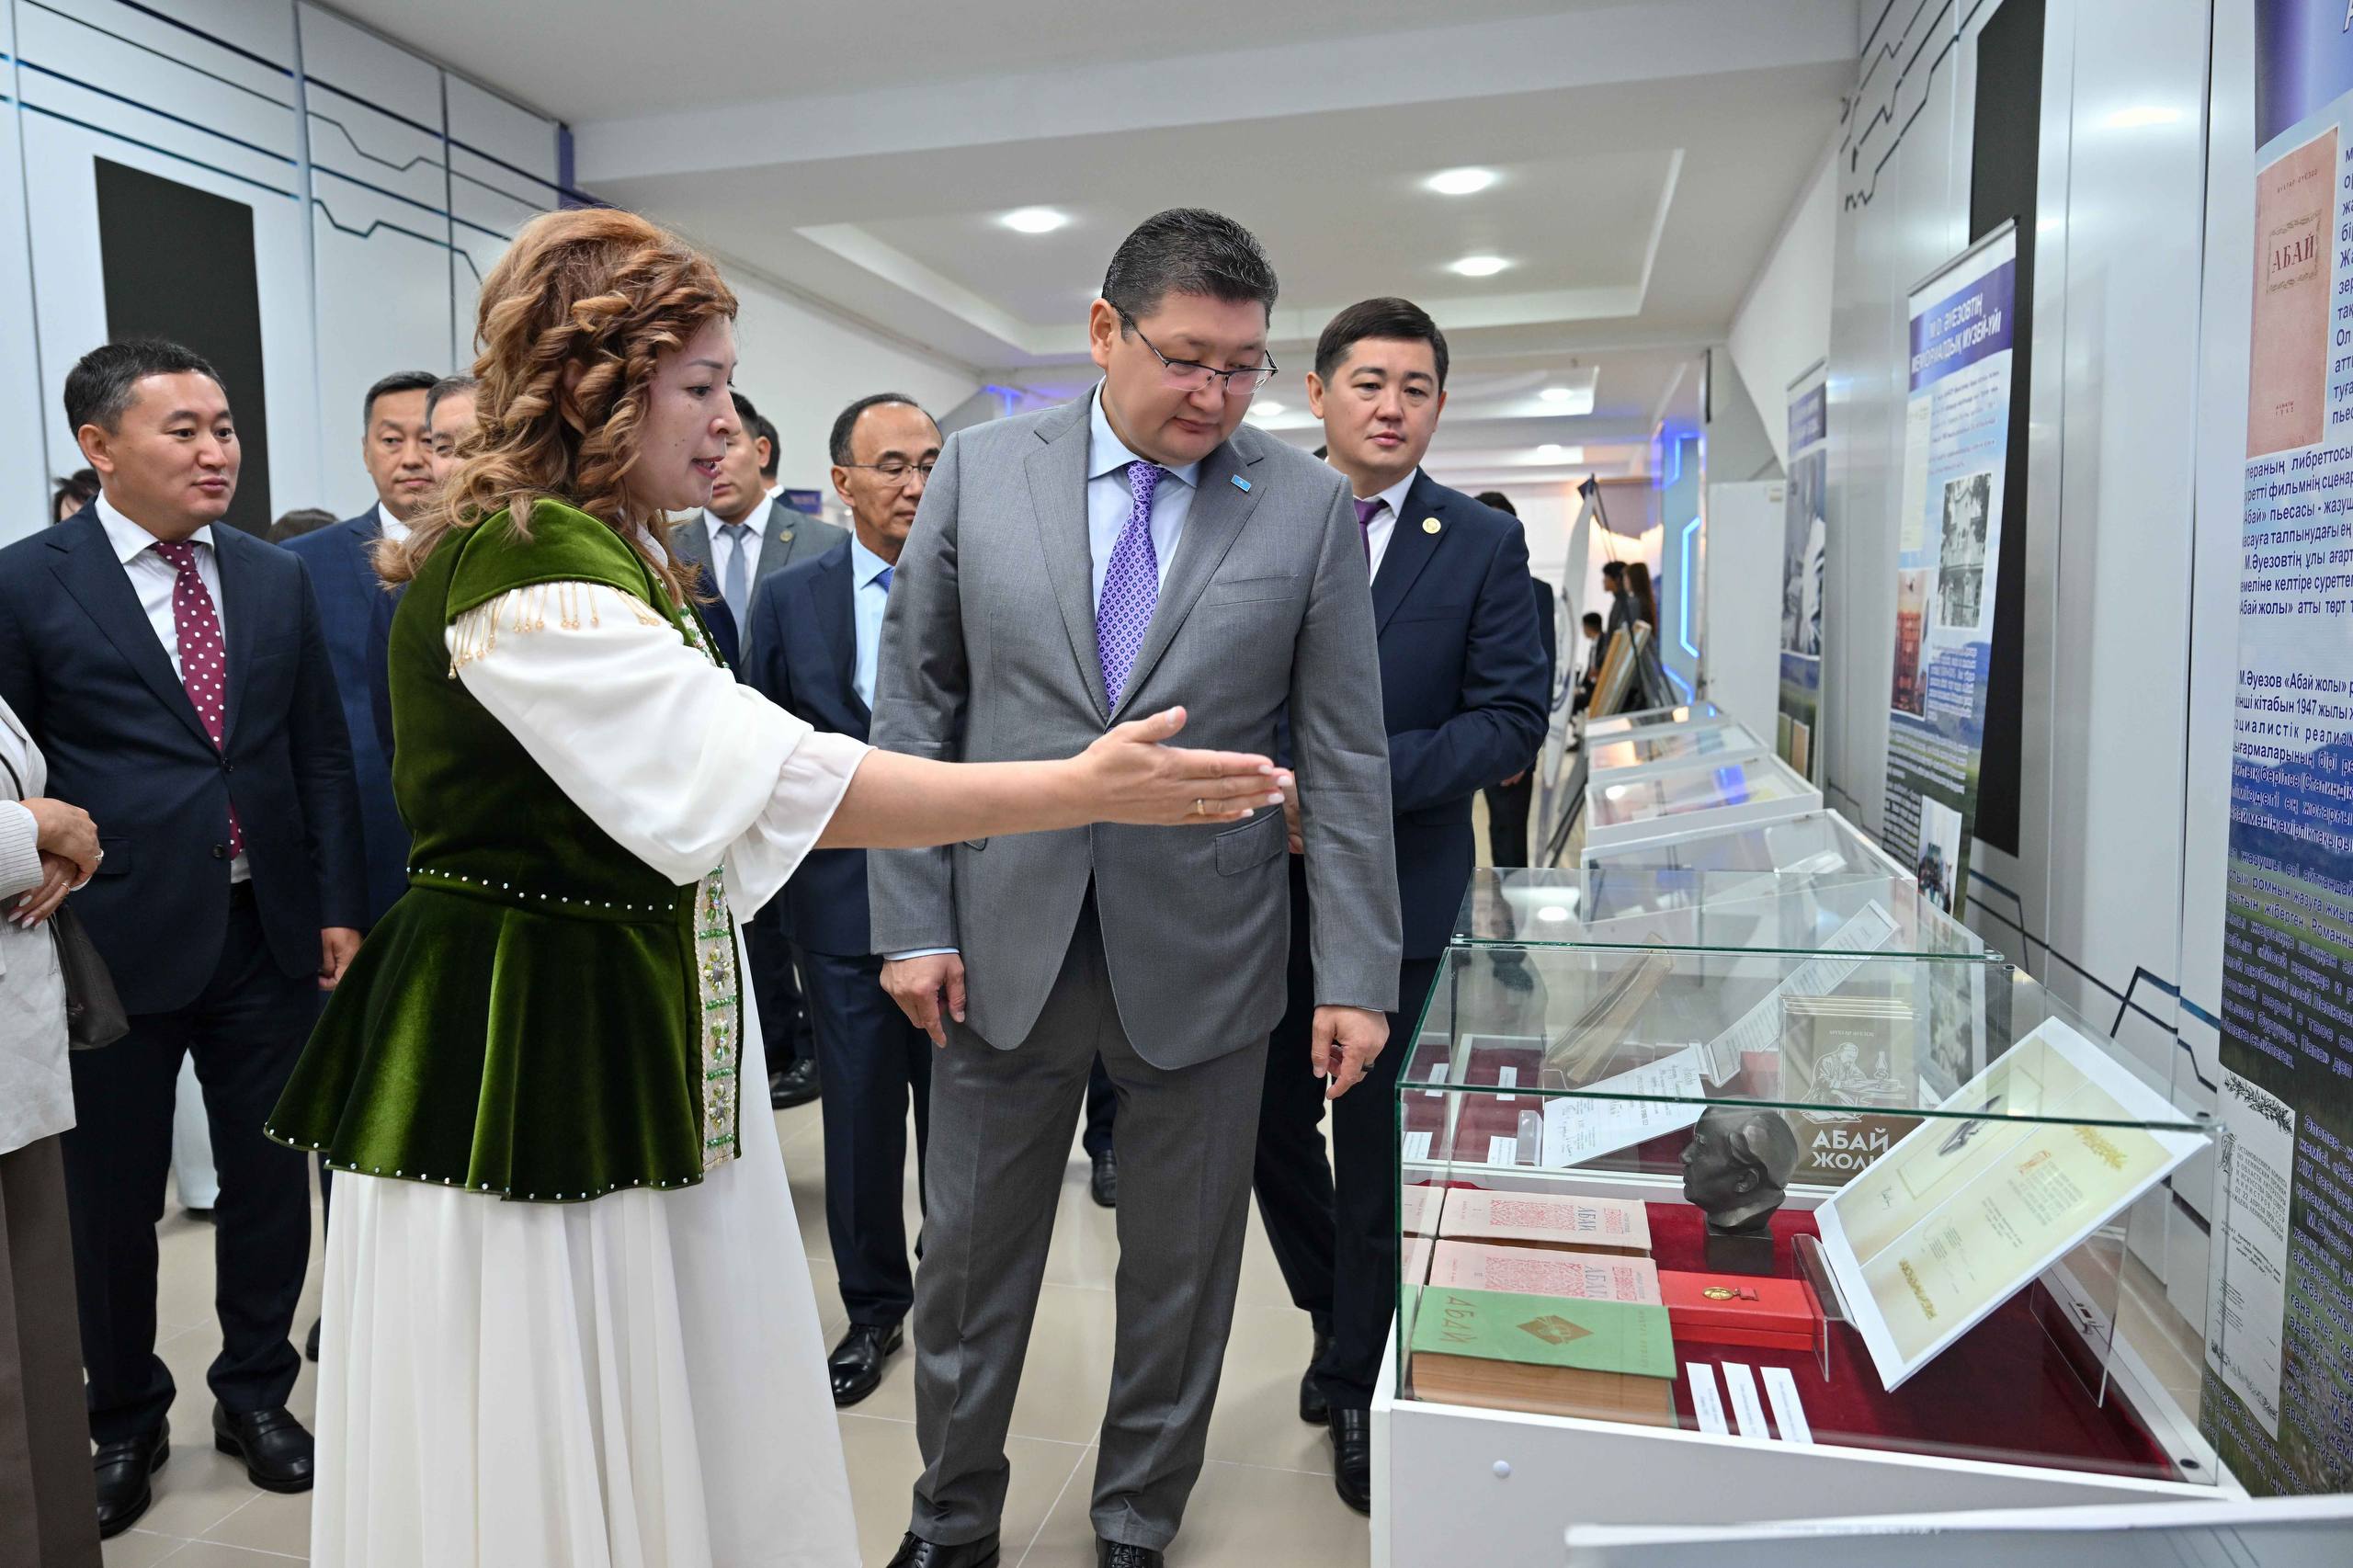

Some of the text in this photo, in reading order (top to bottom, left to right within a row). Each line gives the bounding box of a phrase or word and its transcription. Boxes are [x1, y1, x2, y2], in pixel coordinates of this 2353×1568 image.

[2271, 233, 2316, 274] АБАЙ
[2336, 328, 2351, 347] Ол
[2290, 445, 2353, 471] либреттосы
[2268, 474, 2321, 501] фильмнің
[2269, 503, 2315, 521] пьесасы
[2270, 524, 2339, 544] талпынудағы
[2340, 522, 2352, 539] ең
[2245, 551, 2302, 573] М.Әуезовтің
[2305, 551, 2325, 570] ұлы
[2275, 574, 2312, 594] келтіре
[2258, 602, 2293, 615] жолы»
[2298, 601, 2321, 614] атты
[2325, 599, 2346, 618] төрт
[2239, 670, 2282, 690] М.Әуезов
[2284, 673, 2313, 690] «Абай
[2315, 677, 2347, 692] жолы»
[2254, 695, 2294, 713] кітабын
[2297, 699, 2317, 715] 1947
[2318, 704, 2347, 720] жылы
[2319, 750, 2337, 773] бірі
[2261, 766, 2299, 787] берілсе
[2284, 797, 2299, 815] ең
[2302, 801, 2353, 825] жоғарғы
[2241, 851, 2281, 873] жазушы
[2293, 891, 2323, 912] жазуға
[1812, 1127, 1889, 1153] АБАЙ
[2304, 1114, 2339, 1152] Эпопея
[1812, 1151, 1875, 1170] ЖОЛ
[2290, 1293, 2312, 1318] ғана
